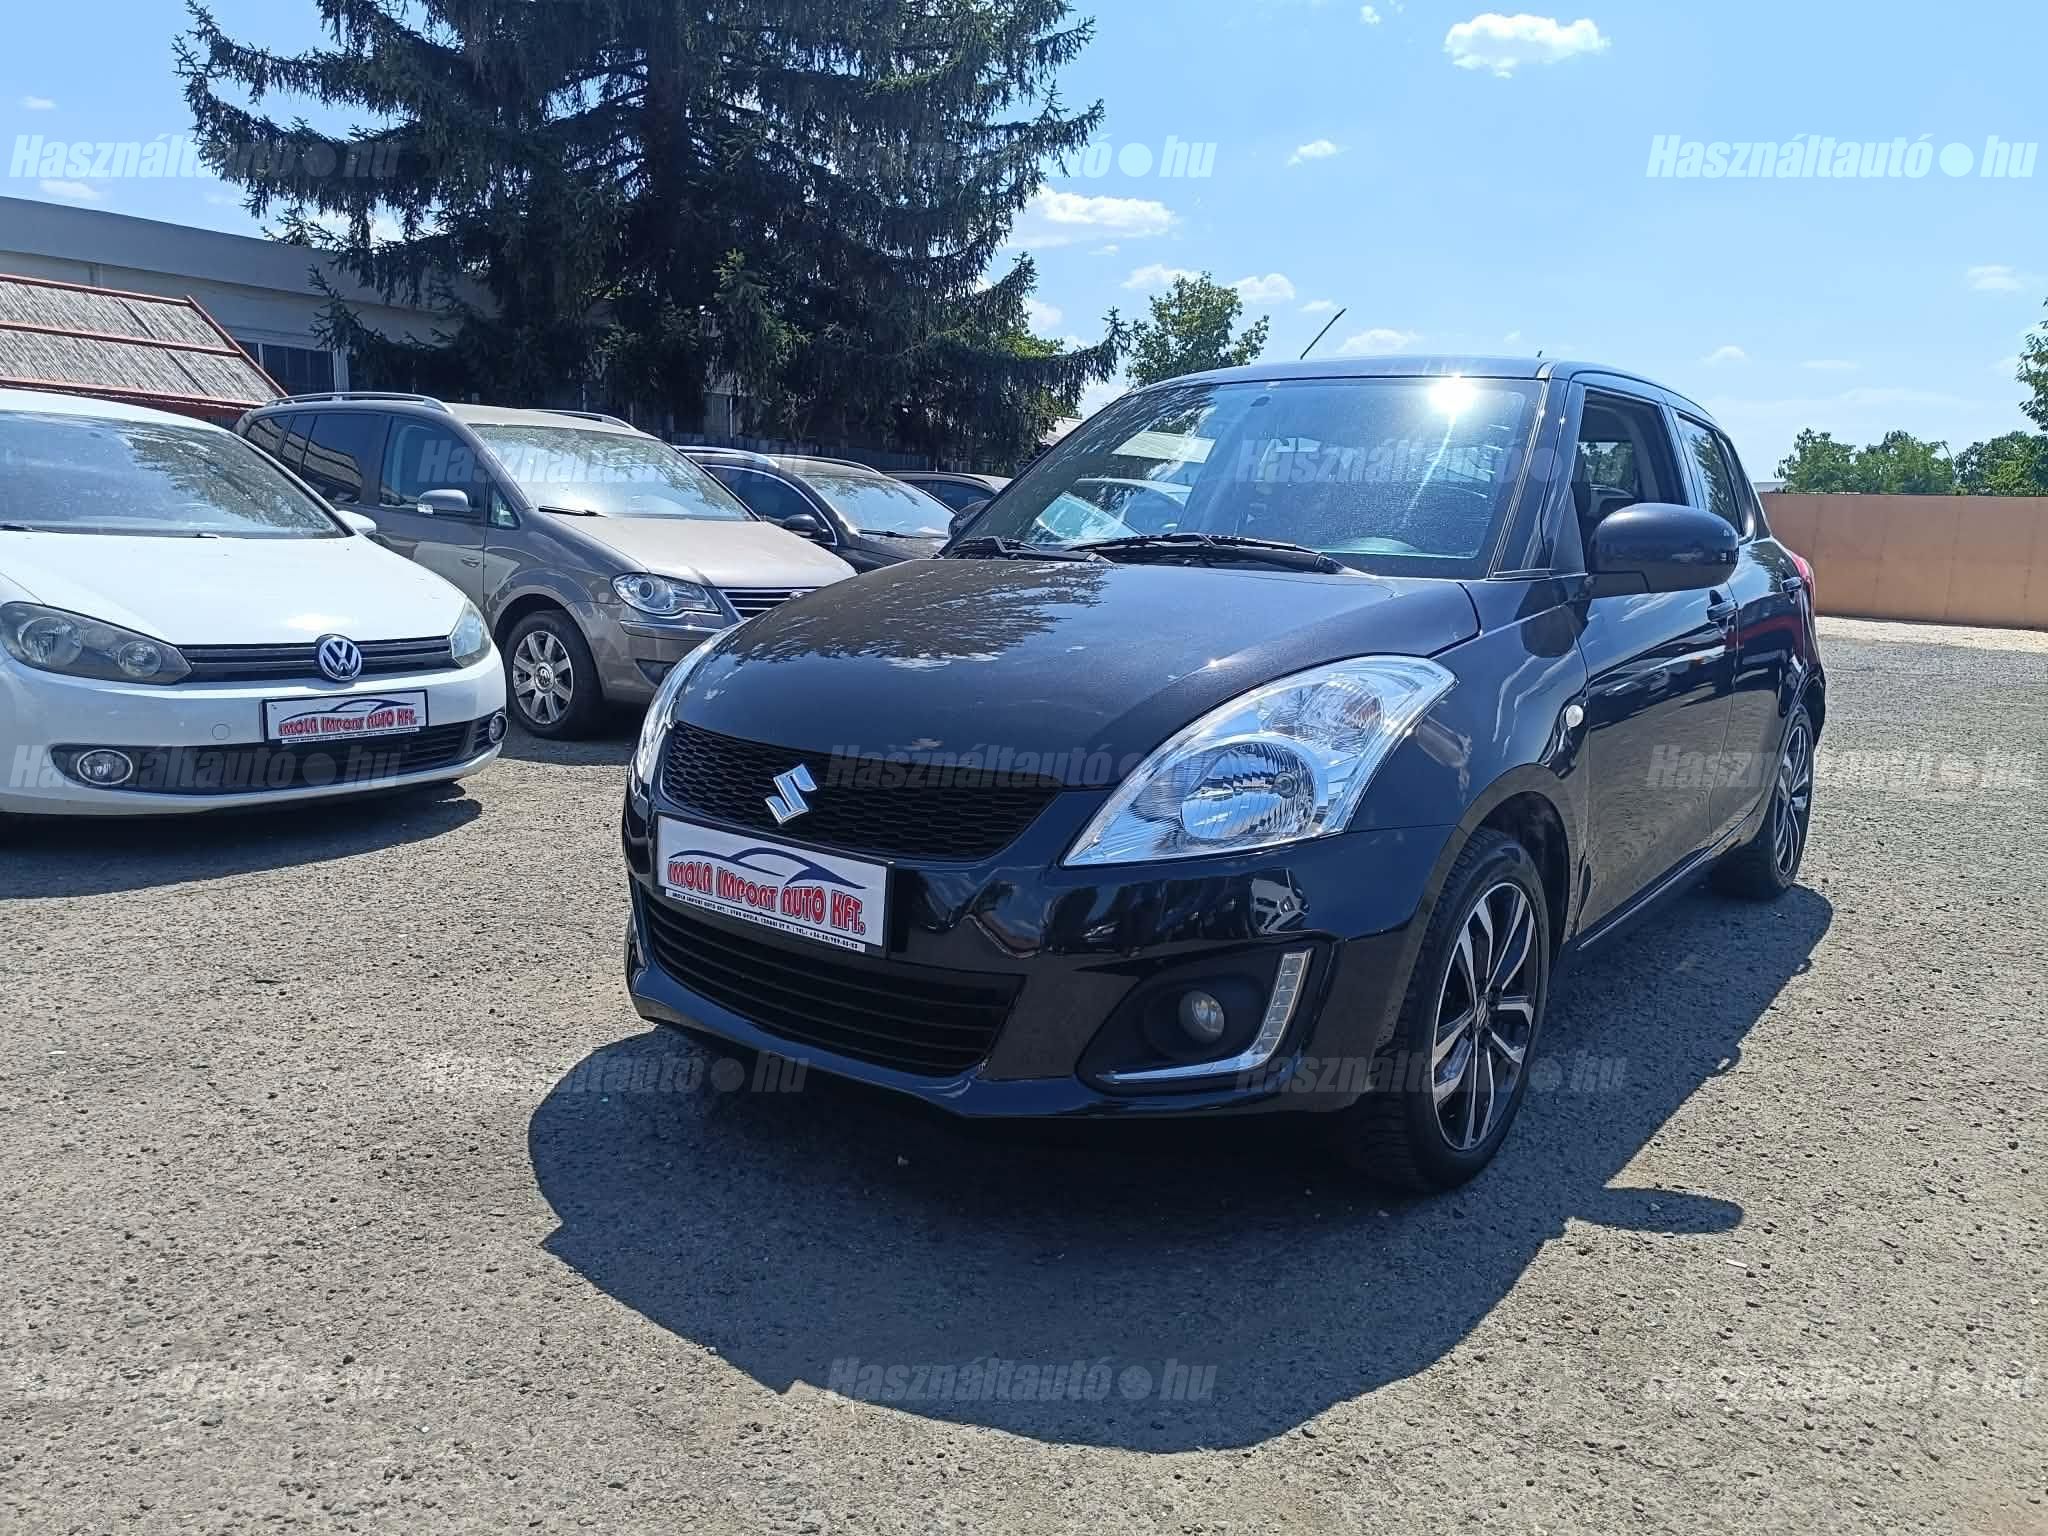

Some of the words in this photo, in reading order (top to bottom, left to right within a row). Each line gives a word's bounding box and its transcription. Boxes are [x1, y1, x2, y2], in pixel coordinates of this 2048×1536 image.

[279, 716, 318, 736] IMOLA
[321, 715, 364, 733] IMPORT
[367, 709, 394, 729] AUTO
[667, 860, 713, 896] IMOLA
[716, 867, 778, 912] IMPORT
[780, 885, 827, 924] AUTO
